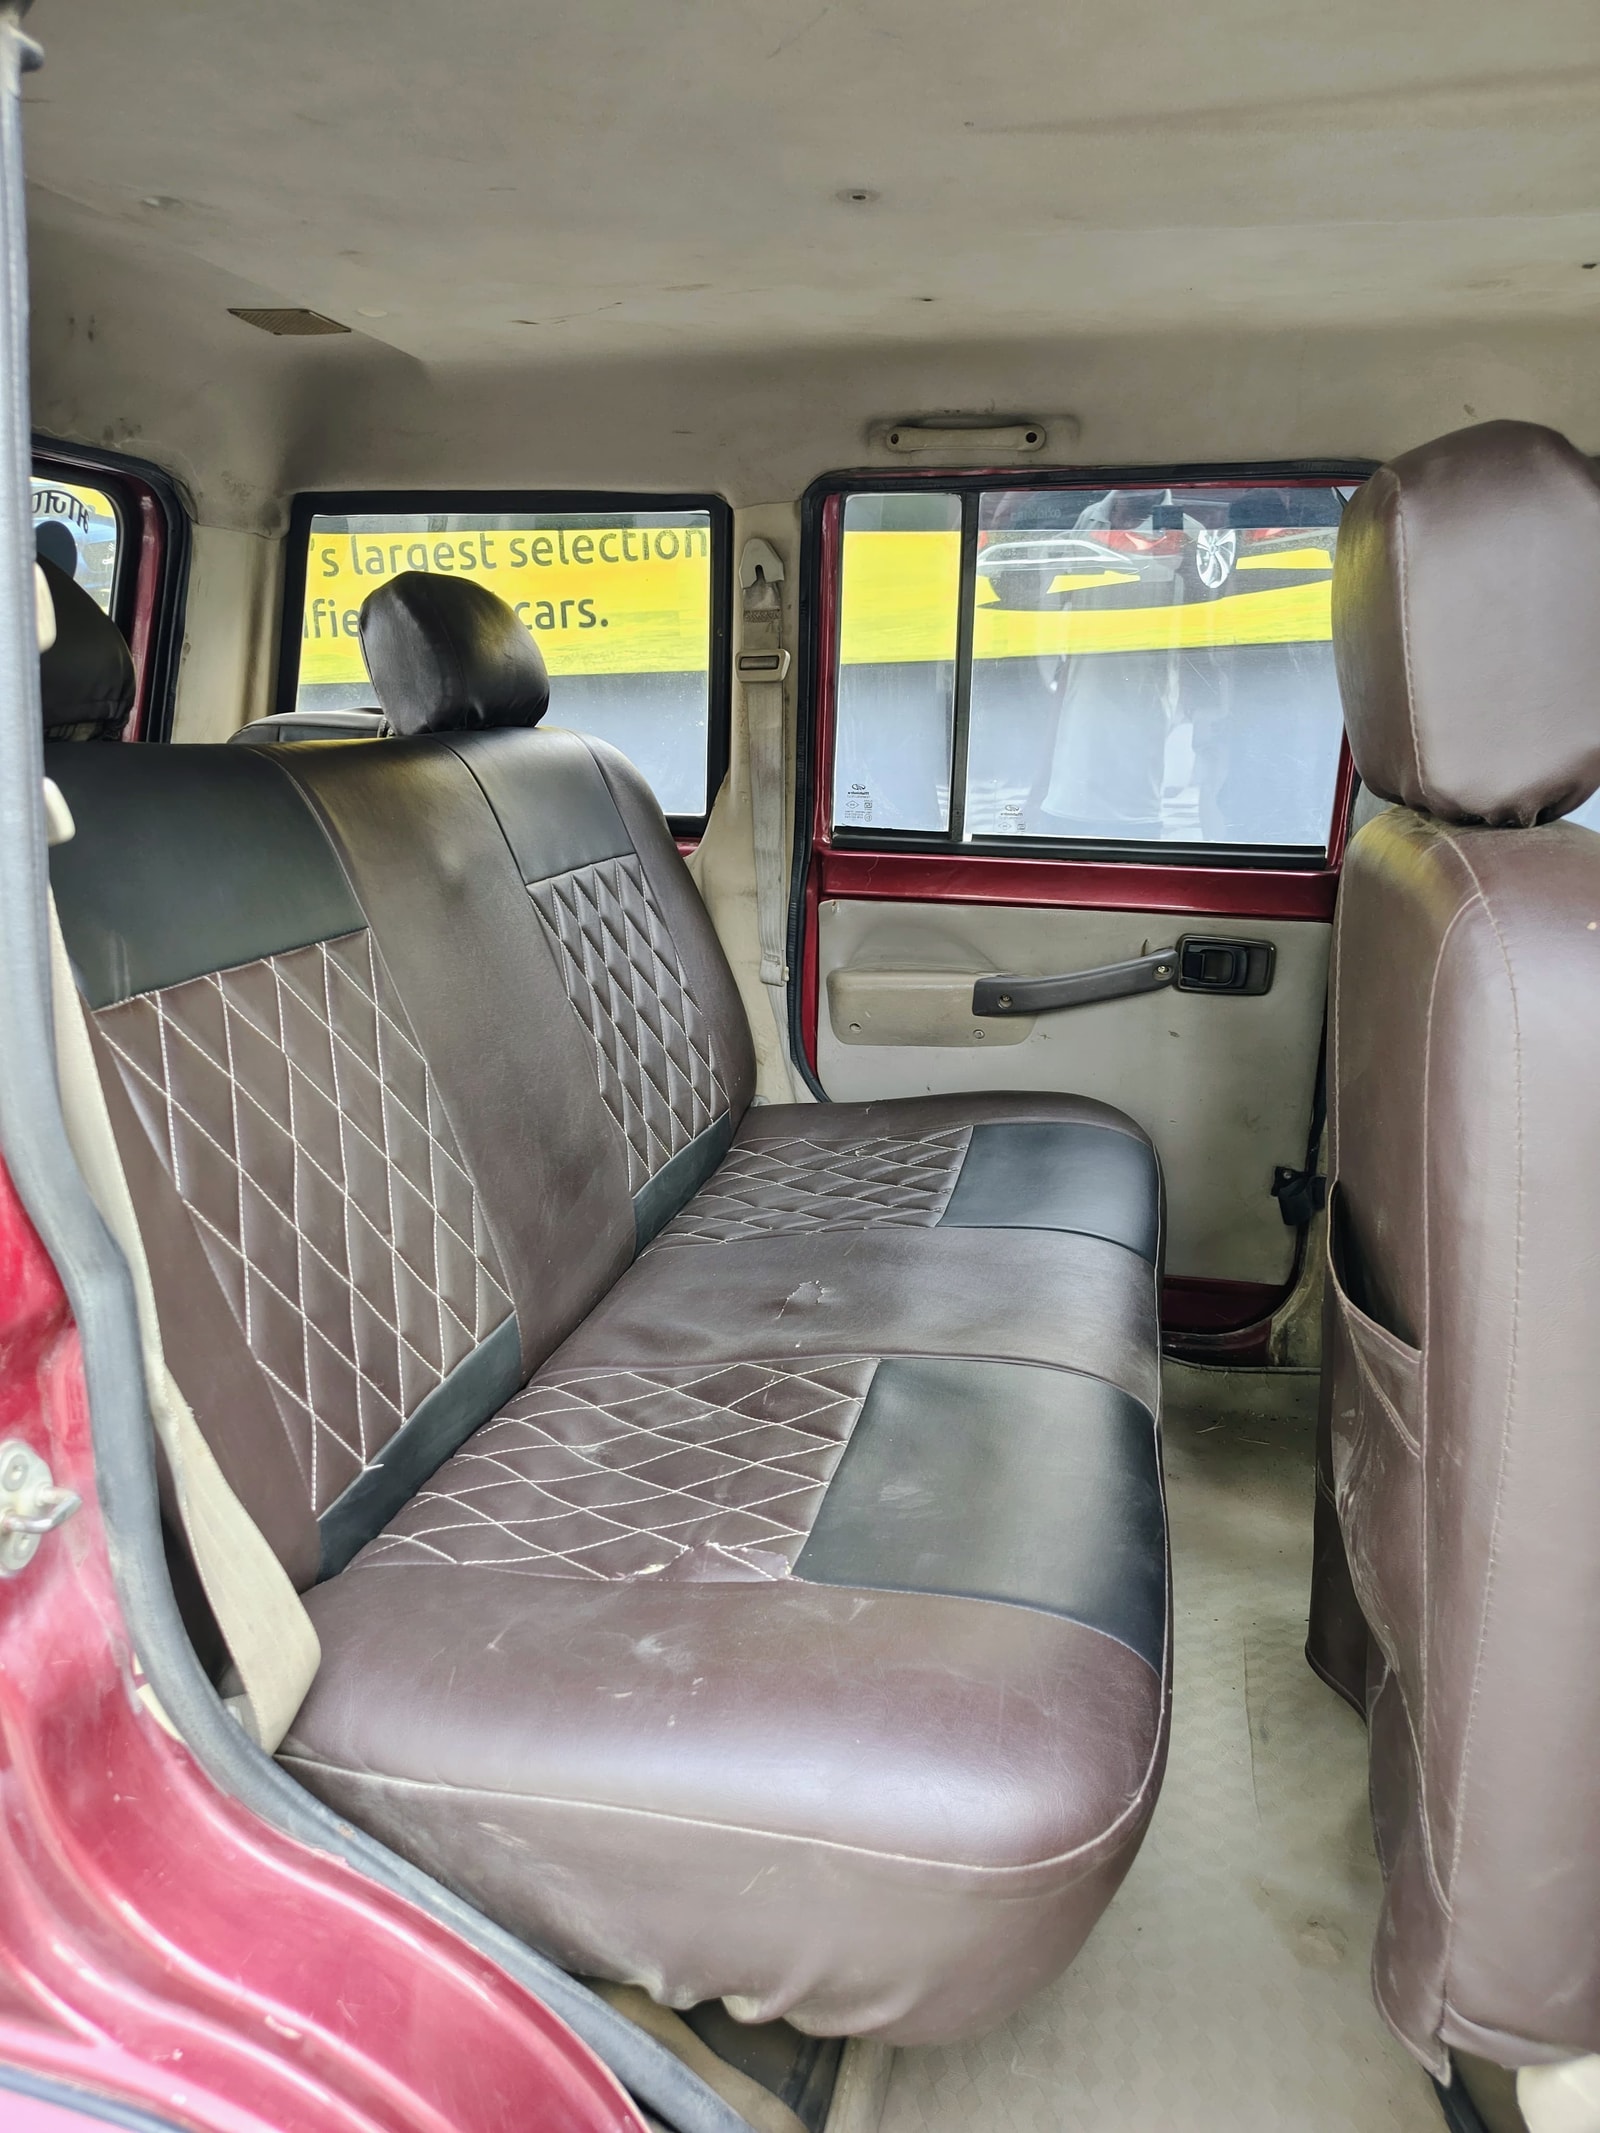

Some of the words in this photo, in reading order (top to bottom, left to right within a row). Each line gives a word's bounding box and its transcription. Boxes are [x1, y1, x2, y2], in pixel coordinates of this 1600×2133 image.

[351, 532, 497, 575] largest
[509, 526, 707, 568] selection
[304, 598, 360, 638] fie
[514, 598, 609, 631] cars.
